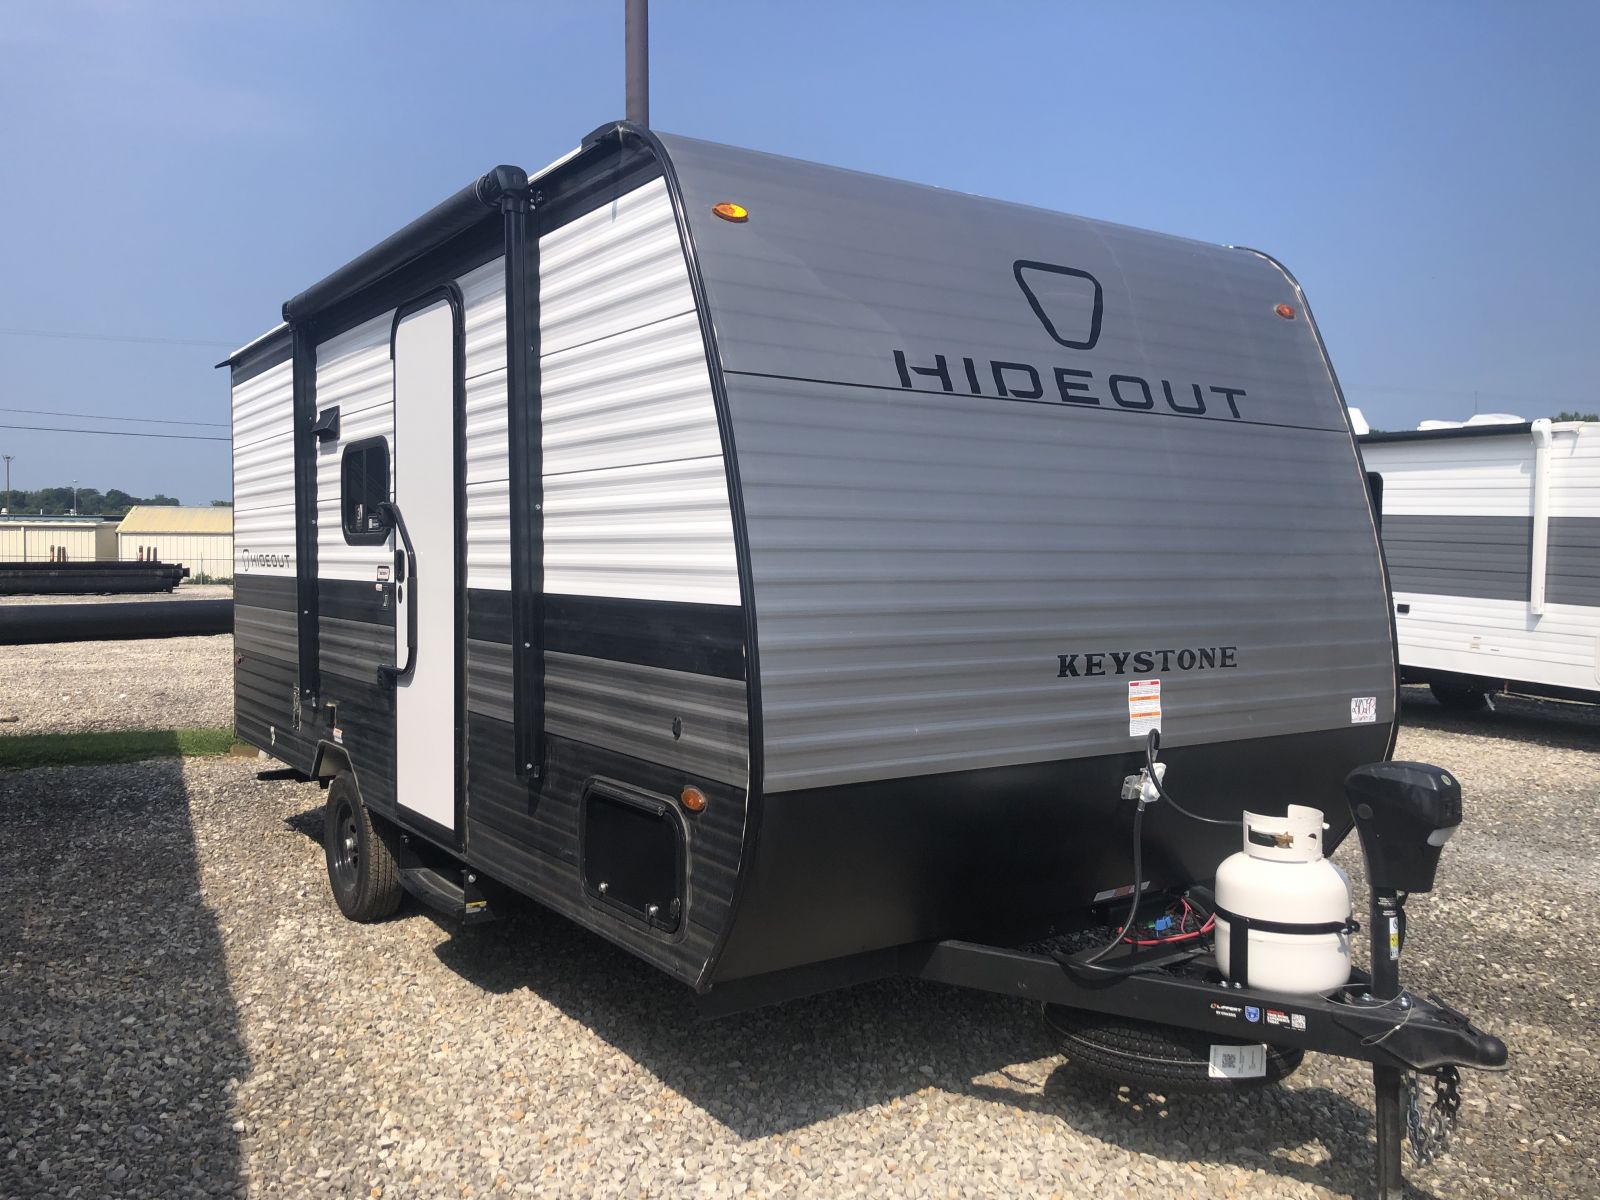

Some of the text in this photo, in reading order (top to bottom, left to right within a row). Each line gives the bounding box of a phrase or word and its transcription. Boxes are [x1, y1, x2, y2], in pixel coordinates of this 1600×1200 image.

[893, 350, 1247, 419] HIDEOUT
[250, 554, 290, 568] HIDEOUT
[1057, 646, 1238, 678] KEYSTONE
